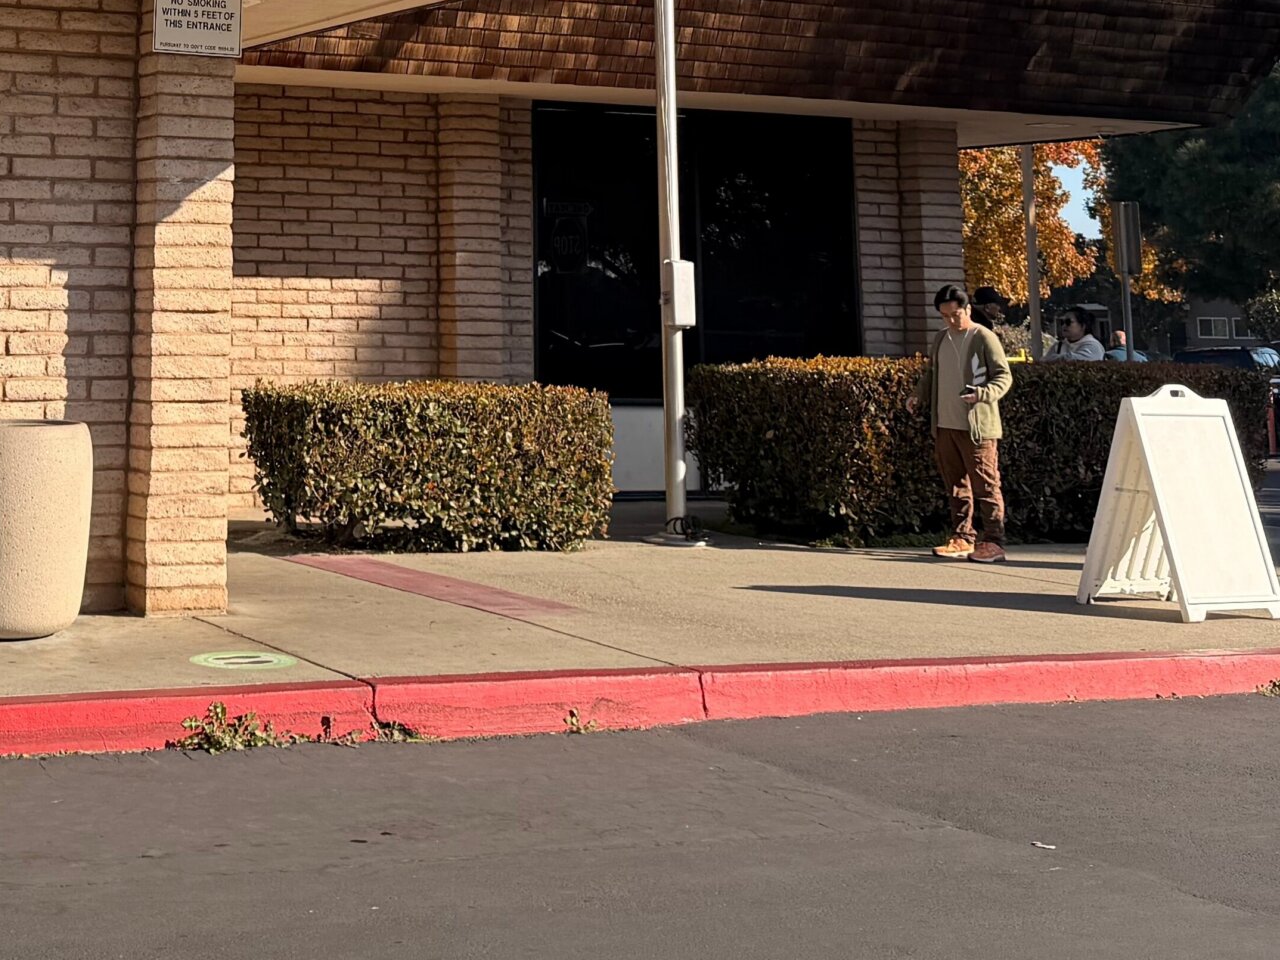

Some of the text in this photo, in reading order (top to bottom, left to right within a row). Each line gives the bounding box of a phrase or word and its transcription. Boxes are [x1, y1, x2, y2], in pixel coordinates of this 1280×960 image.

[162, 7, 235, 20] WITHIN 5 FEET OF
[165, 19, 232, 32] THIS ENTRANCE
